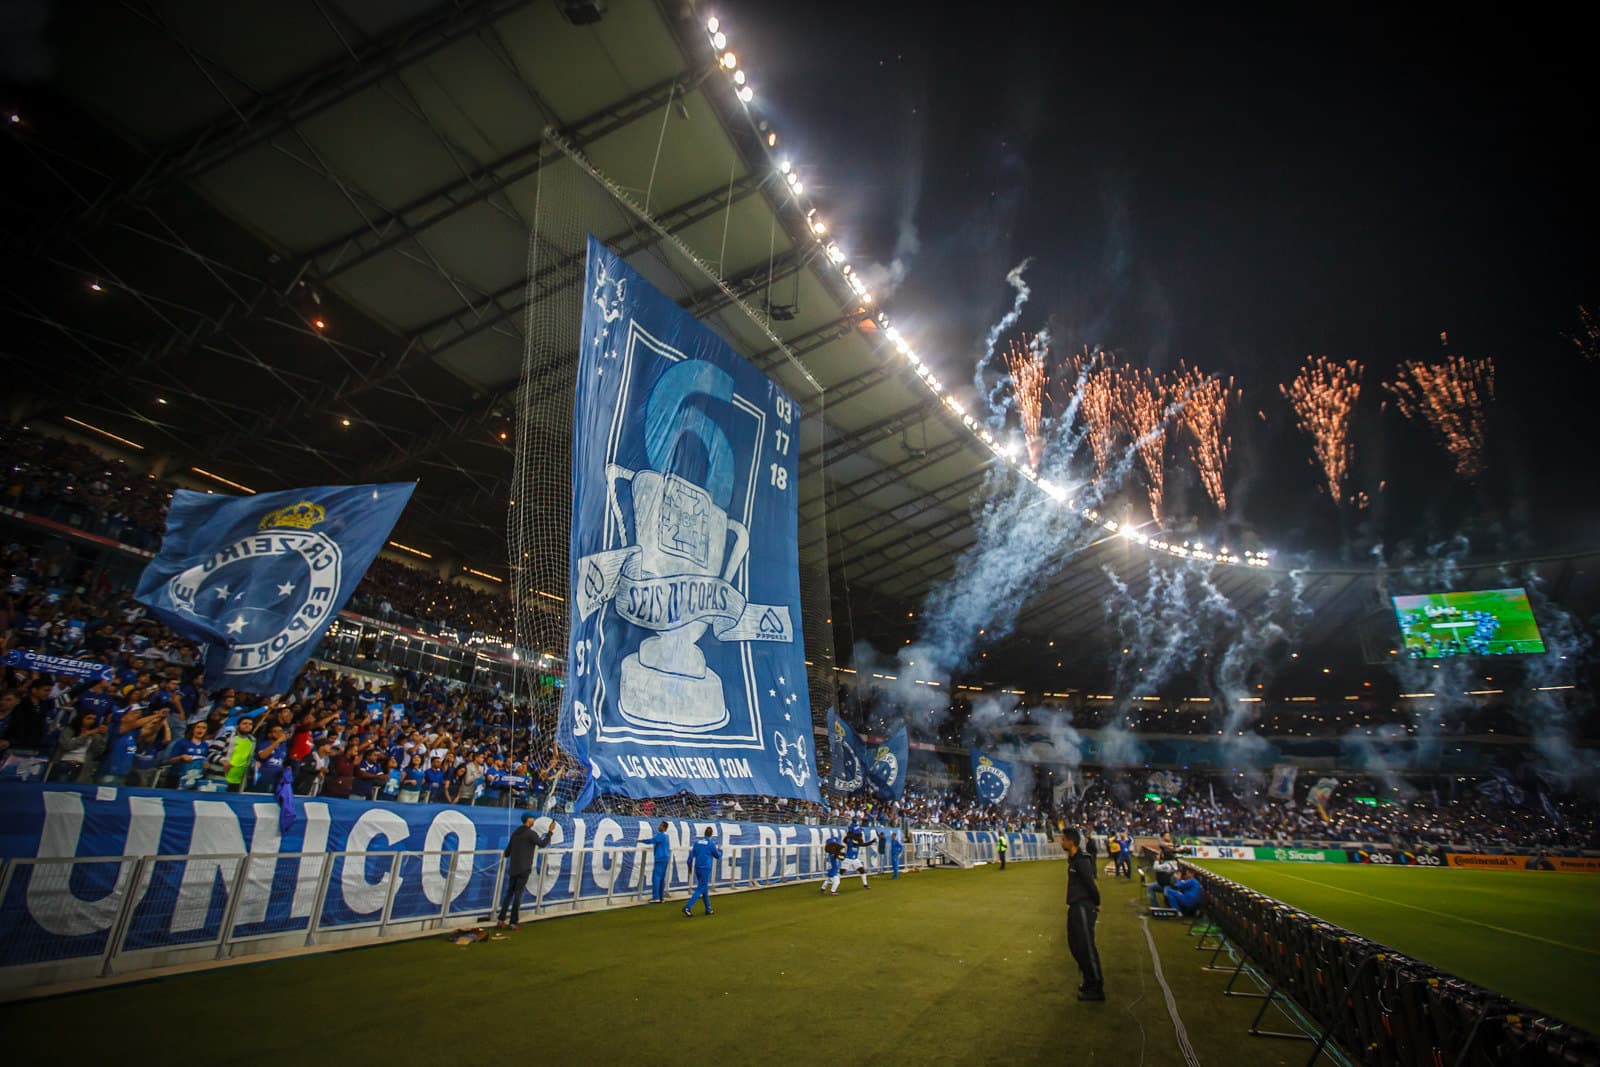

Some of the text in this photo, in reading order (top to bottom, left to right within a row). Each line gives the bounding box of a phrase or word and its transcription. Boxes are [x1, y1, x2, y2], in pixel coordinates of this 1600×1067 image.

[776, 396, 792, 424] 03
[776, 429, 790, 456] 17
[770, 462, 788, 490] 18
[627, 586, 663, 624] SEIS
[687, 581, 728, 615] COPAS
[24, 652, 103, 671] CRUZEIRO
[758, 826, 797, 880] DE
[1218, 847, 1234, 858] Sil
[1288, 850, 1326, 861] Sicredi
[1370, 852, 1393, 864] elo
[1416, 854, 1441, 866] elo
[1454, 855, 1508, 866] Continental
